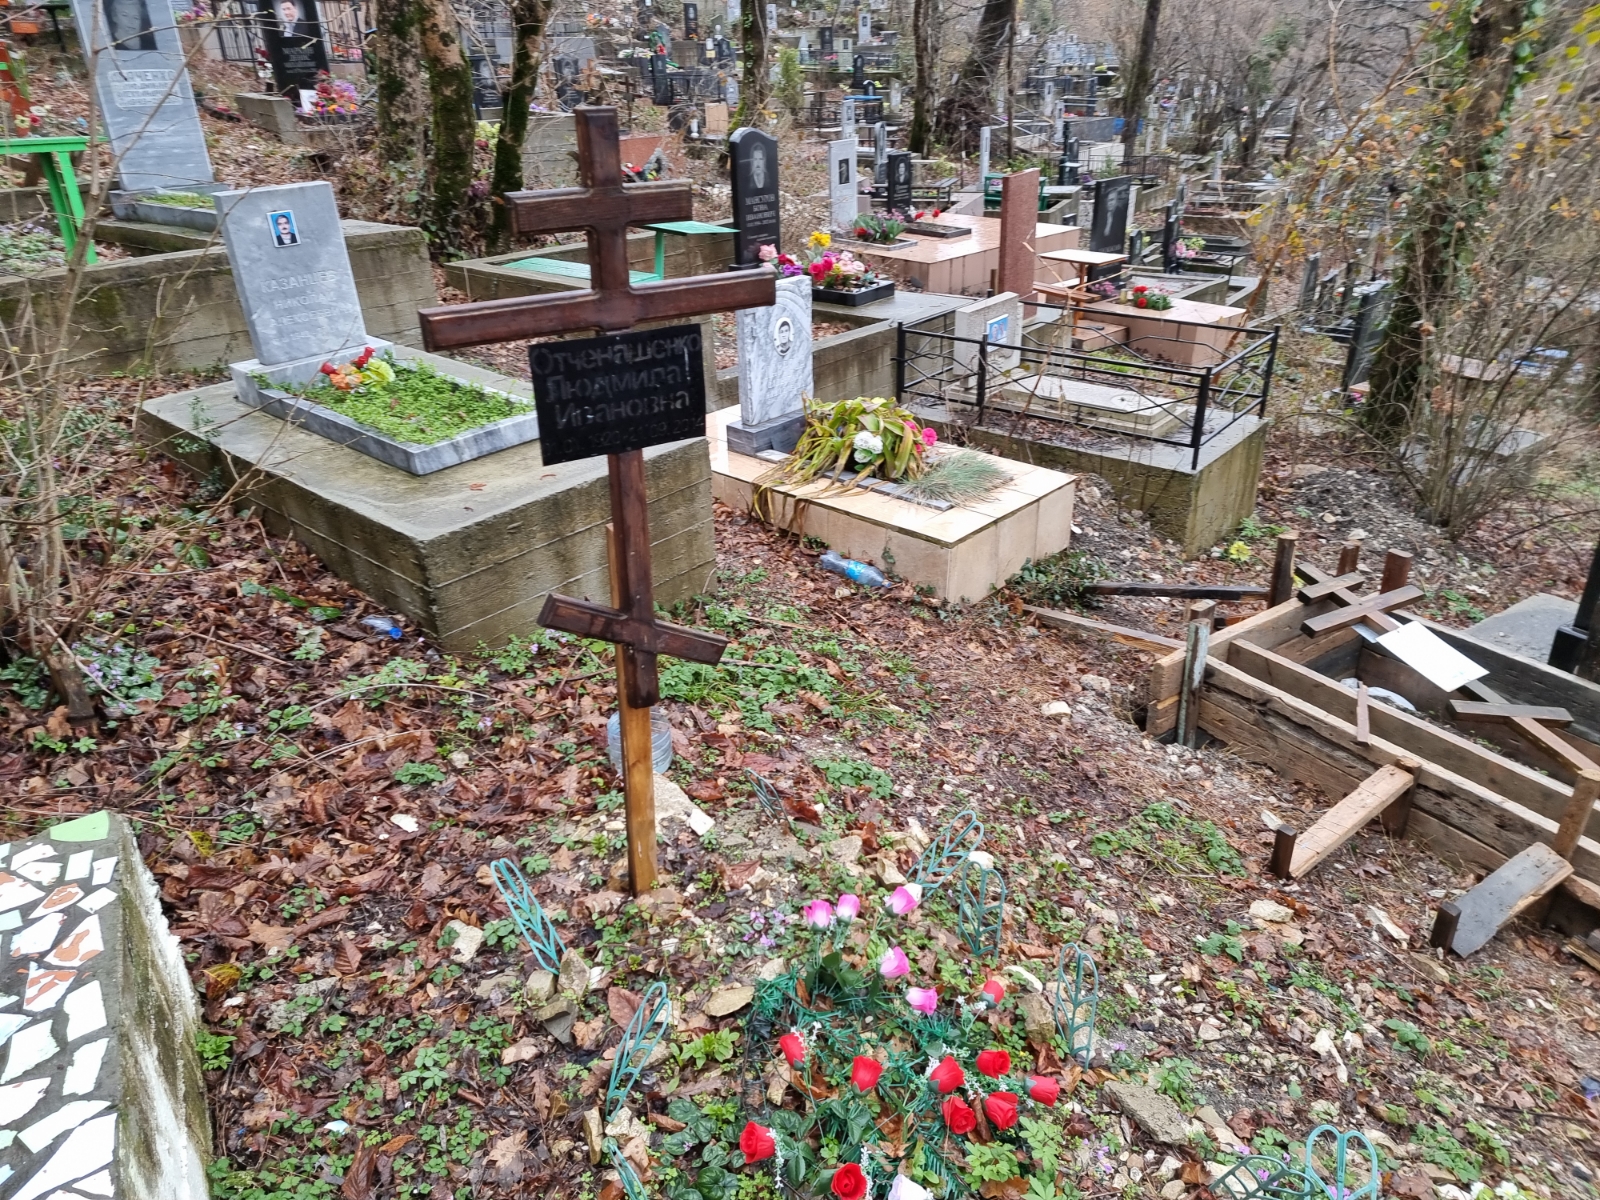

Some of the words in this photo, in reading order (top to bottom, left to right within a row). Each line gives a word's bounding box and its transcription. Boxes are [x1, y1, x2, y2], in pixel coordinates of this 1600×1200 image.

[260, 270, 336, 293] КАЗАНЦЕВ
[545, 365, 682, 403] Людмила
[554, 390, 690, 429] Ивановна
